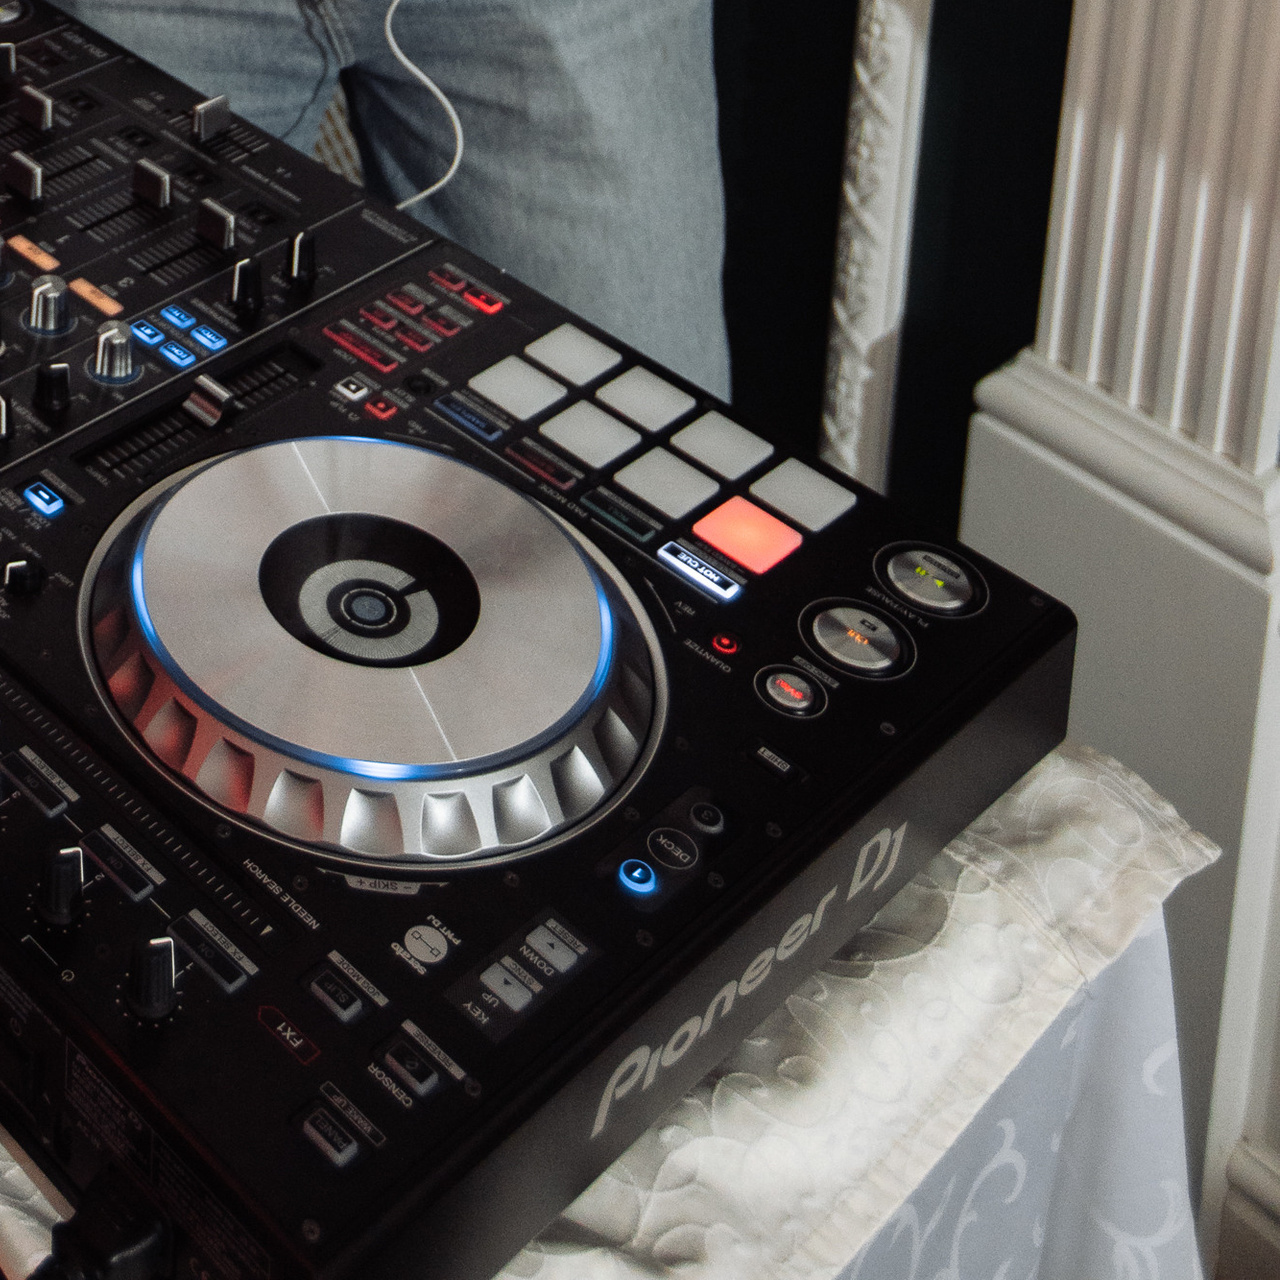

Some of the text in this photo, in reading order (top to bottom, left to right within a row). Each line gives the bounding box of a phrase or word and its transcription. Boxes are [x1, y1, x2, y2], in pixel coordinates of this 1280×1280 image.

[536, 479, 570, 506] MODE
[674, 548, 721, 583] HOT CUE
[673, 596, 697, 617] REV
[863, 582, 930, 629] PLAY/PAUSE
[681, 636, 733, 674] QUANTIZE
[756, 744, 789, 771] SHIFT
[111, 833, 142, 861] SELECT
[655, 833, 691, 863] DECK
[240, 856, 321, 931] NEEDLE SEARCH
[367, 878, 399, 892] SKIP
[200, 919, 233, 950] SELECT
[549, 921, 581, 949] RESET
[335, 954, 363, 982] MODE
[387, 940, 428, 976] serato
[506, 959, 535, 985] SYNC
[517, 942, 556, 978] DOWN
[321, 977, 350, 1006] SLIP
[591, 821, 909, 1139] Pioneer DJ
[462, 997, 491, 1025] KEY
[480, 988, 501, 1008] UP
[274, 1018, 305, 1049] FX1
[411, 1027, 455, 1069] REVERSE
[365, 1061, 415, 1109] CENSOR
[309, 1112, 349, 1152] PANEL
[343, 1103, 375, 1133] WAKE
